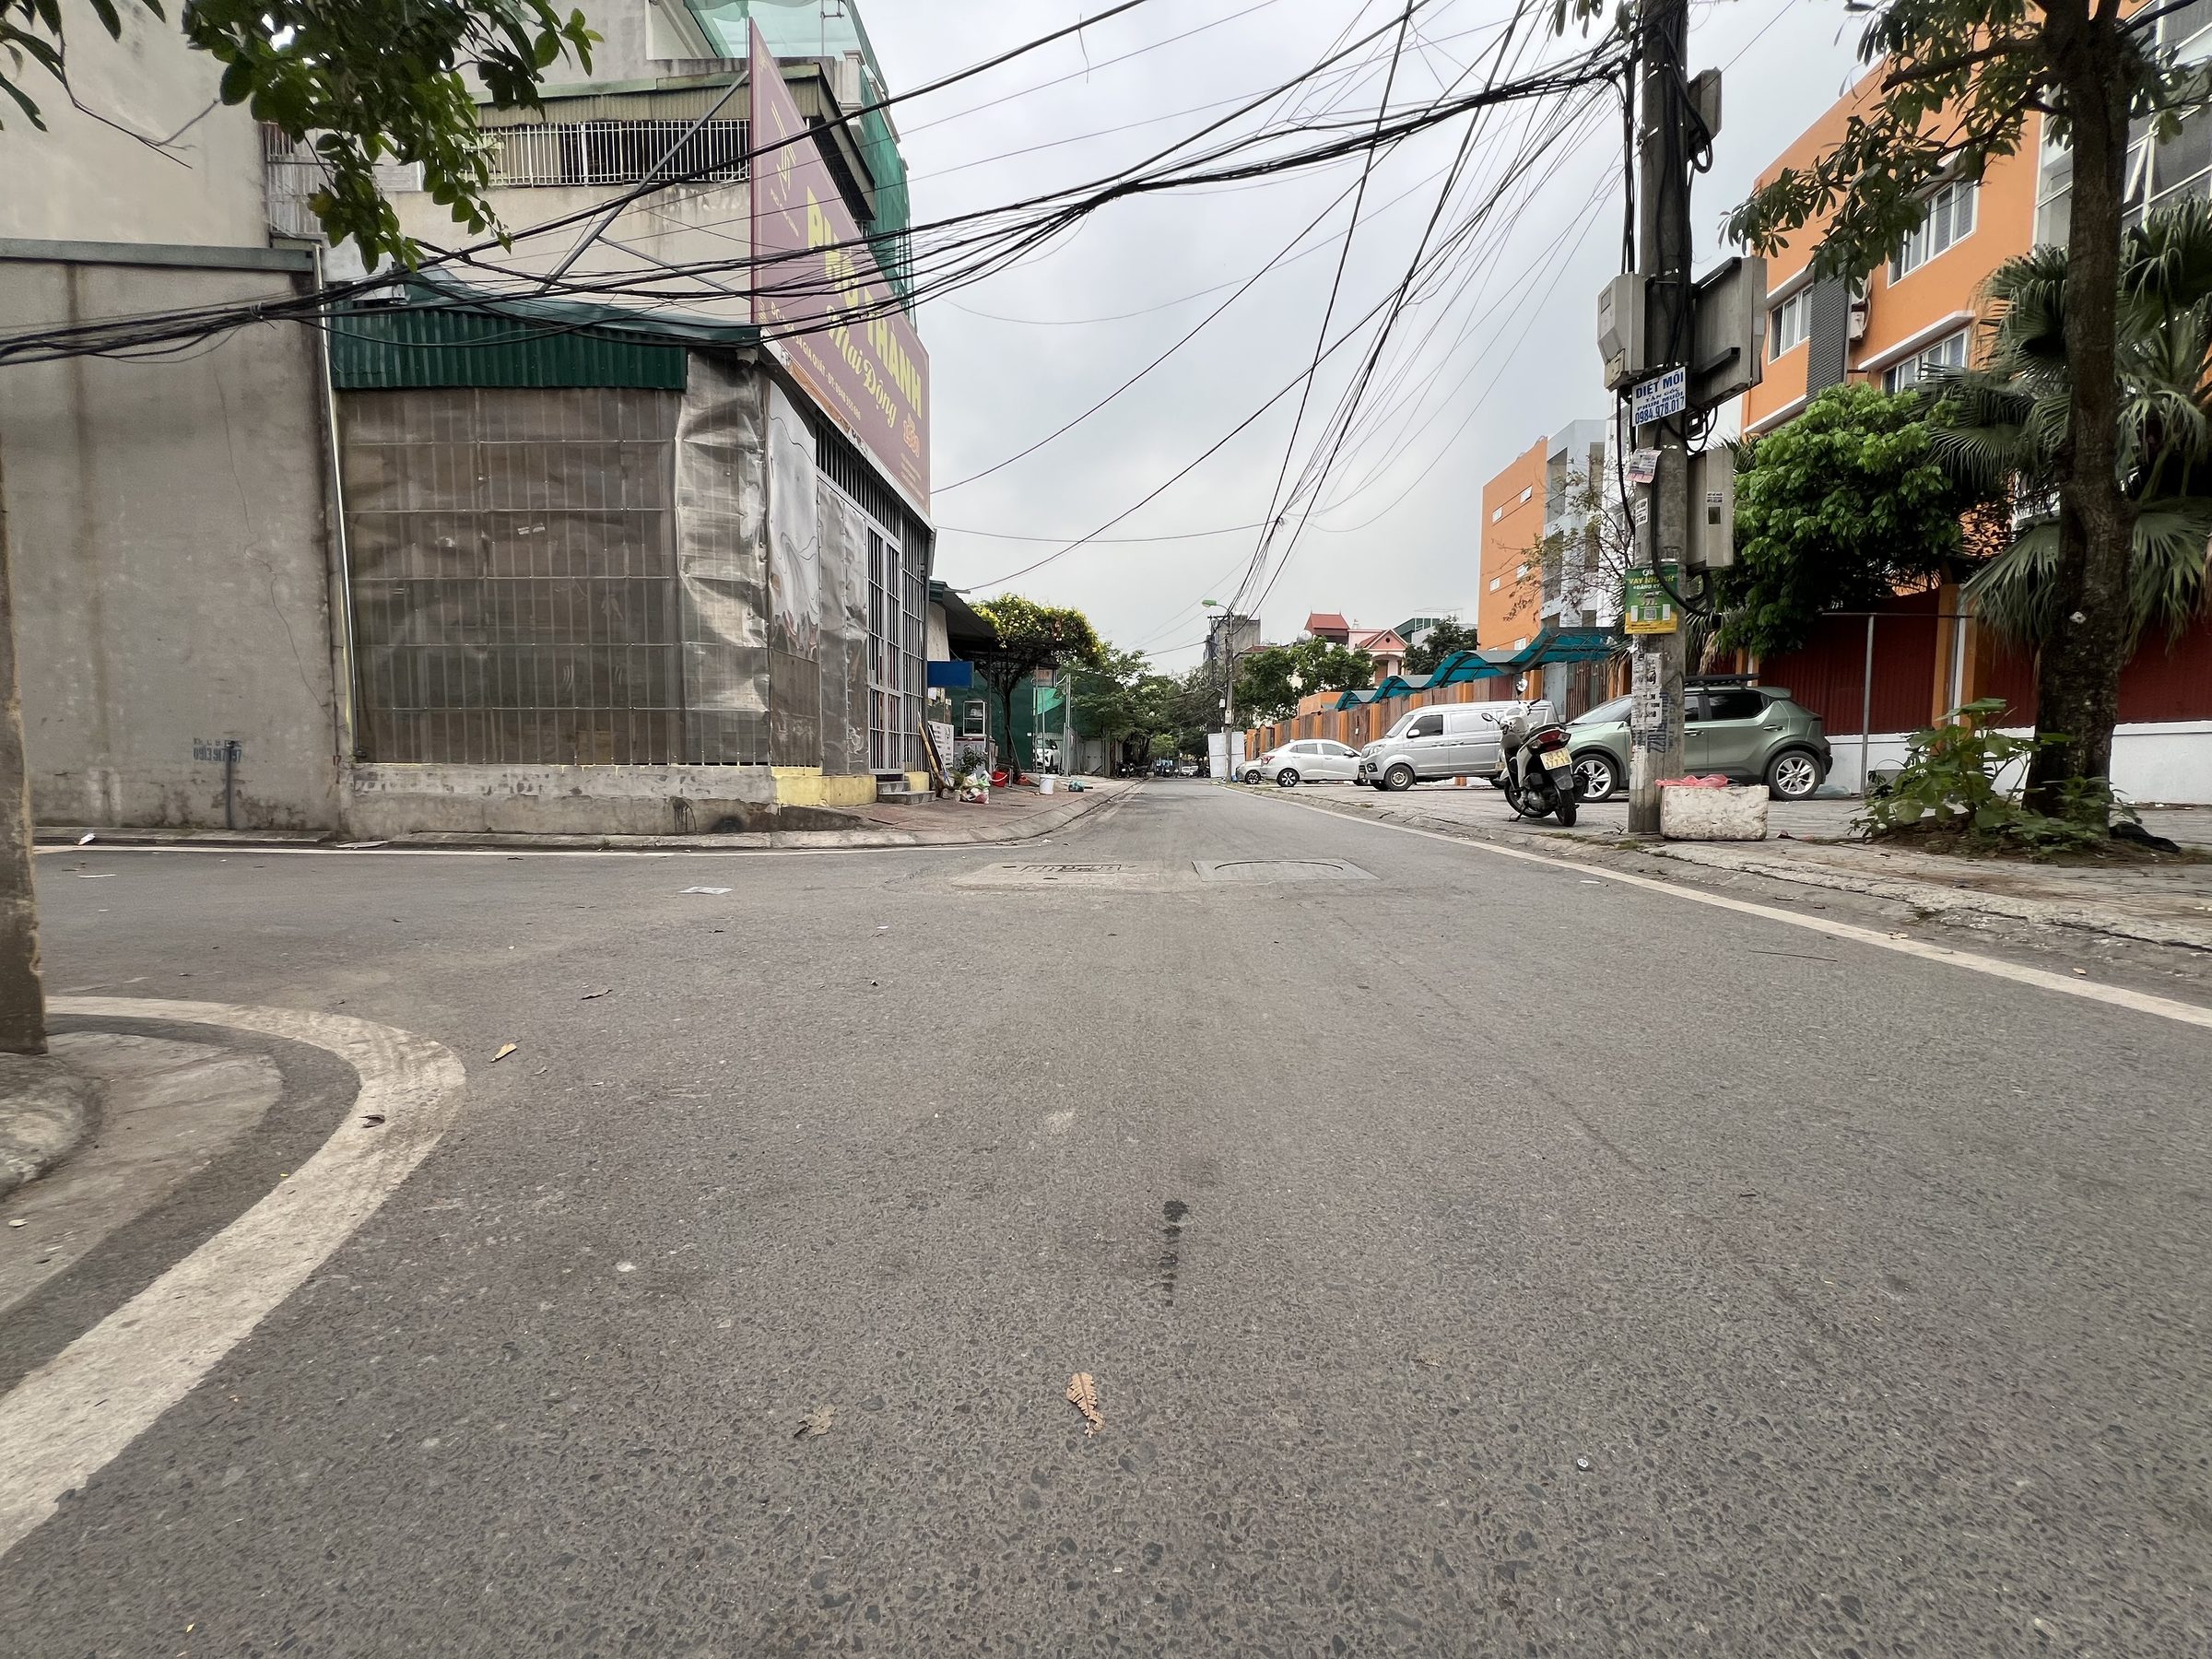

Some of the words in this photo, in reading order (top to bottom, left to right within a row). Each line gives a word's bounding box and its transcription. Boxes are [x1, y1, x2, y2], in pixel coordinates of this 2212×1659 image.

[827, 304, 863, 375] Mai
[863, 359, 897, 429] Động
[864, 286, 922, 420] THÀNH
[1636, 381, 1659, 398] DIỆT
[1663, 370, 1684, 389] MỐI
[1635, 395, 1685, 425] 0984.978.017
[1645, 575, 1674, 584] NHNH
